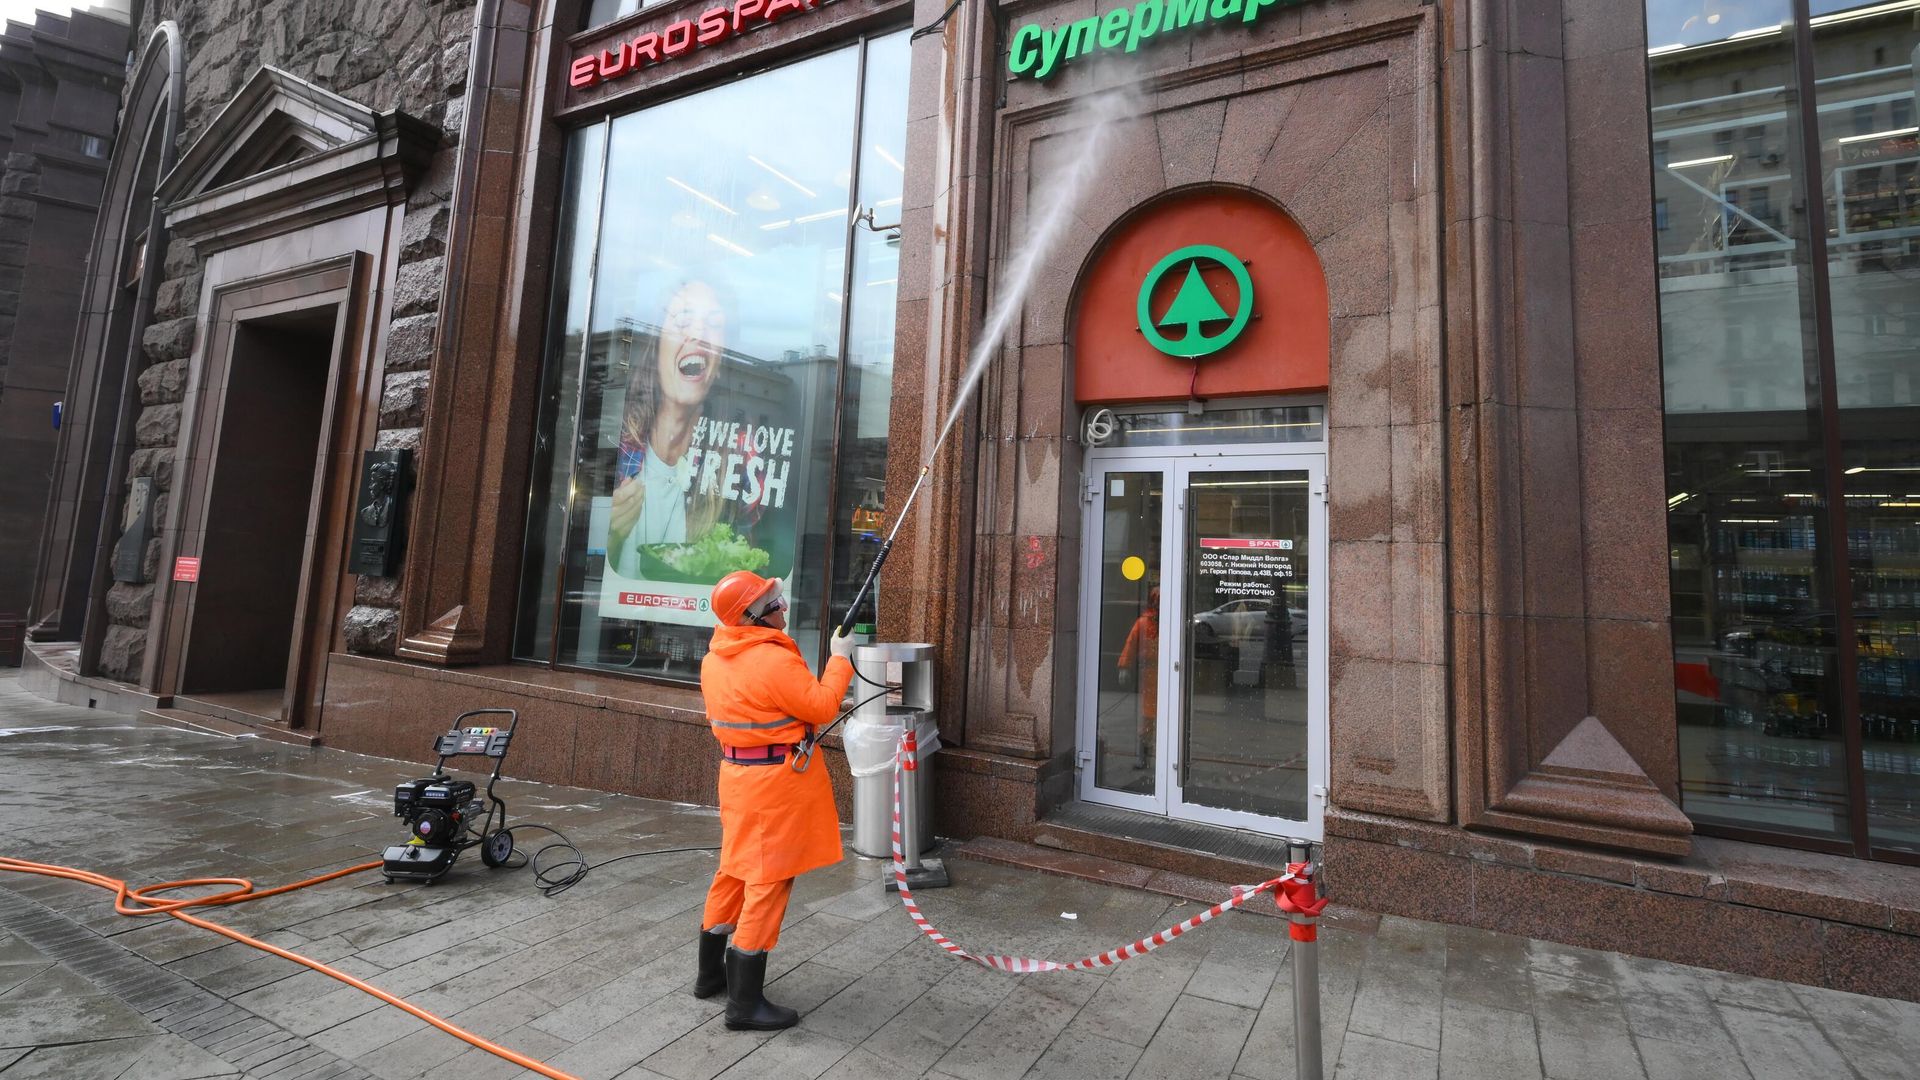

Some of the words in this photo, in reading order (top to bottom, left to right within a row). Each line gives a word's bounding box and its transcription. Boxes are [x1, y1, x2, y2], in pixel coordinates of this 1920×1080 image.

[570, 0, 822, 89] EUROSPA
[692, 416, 740, 448] #WE
[744, 424, 795, 457] LOVE
[683, 446, 790, 509] FRESH
[1248, 540, 1280, 548] SPAR
[1219, 553, 1240, 561] «Спар
[1258, 562, 1292, 570] Новгород
[1219, 580, 1242, 588] Режим
[1242, 581, 1271, 589] работы:
[1215, 587, 1276, 596] КРУГЛОСУТОЧНО
[626, 594, 697, 609] EUROSPAR
